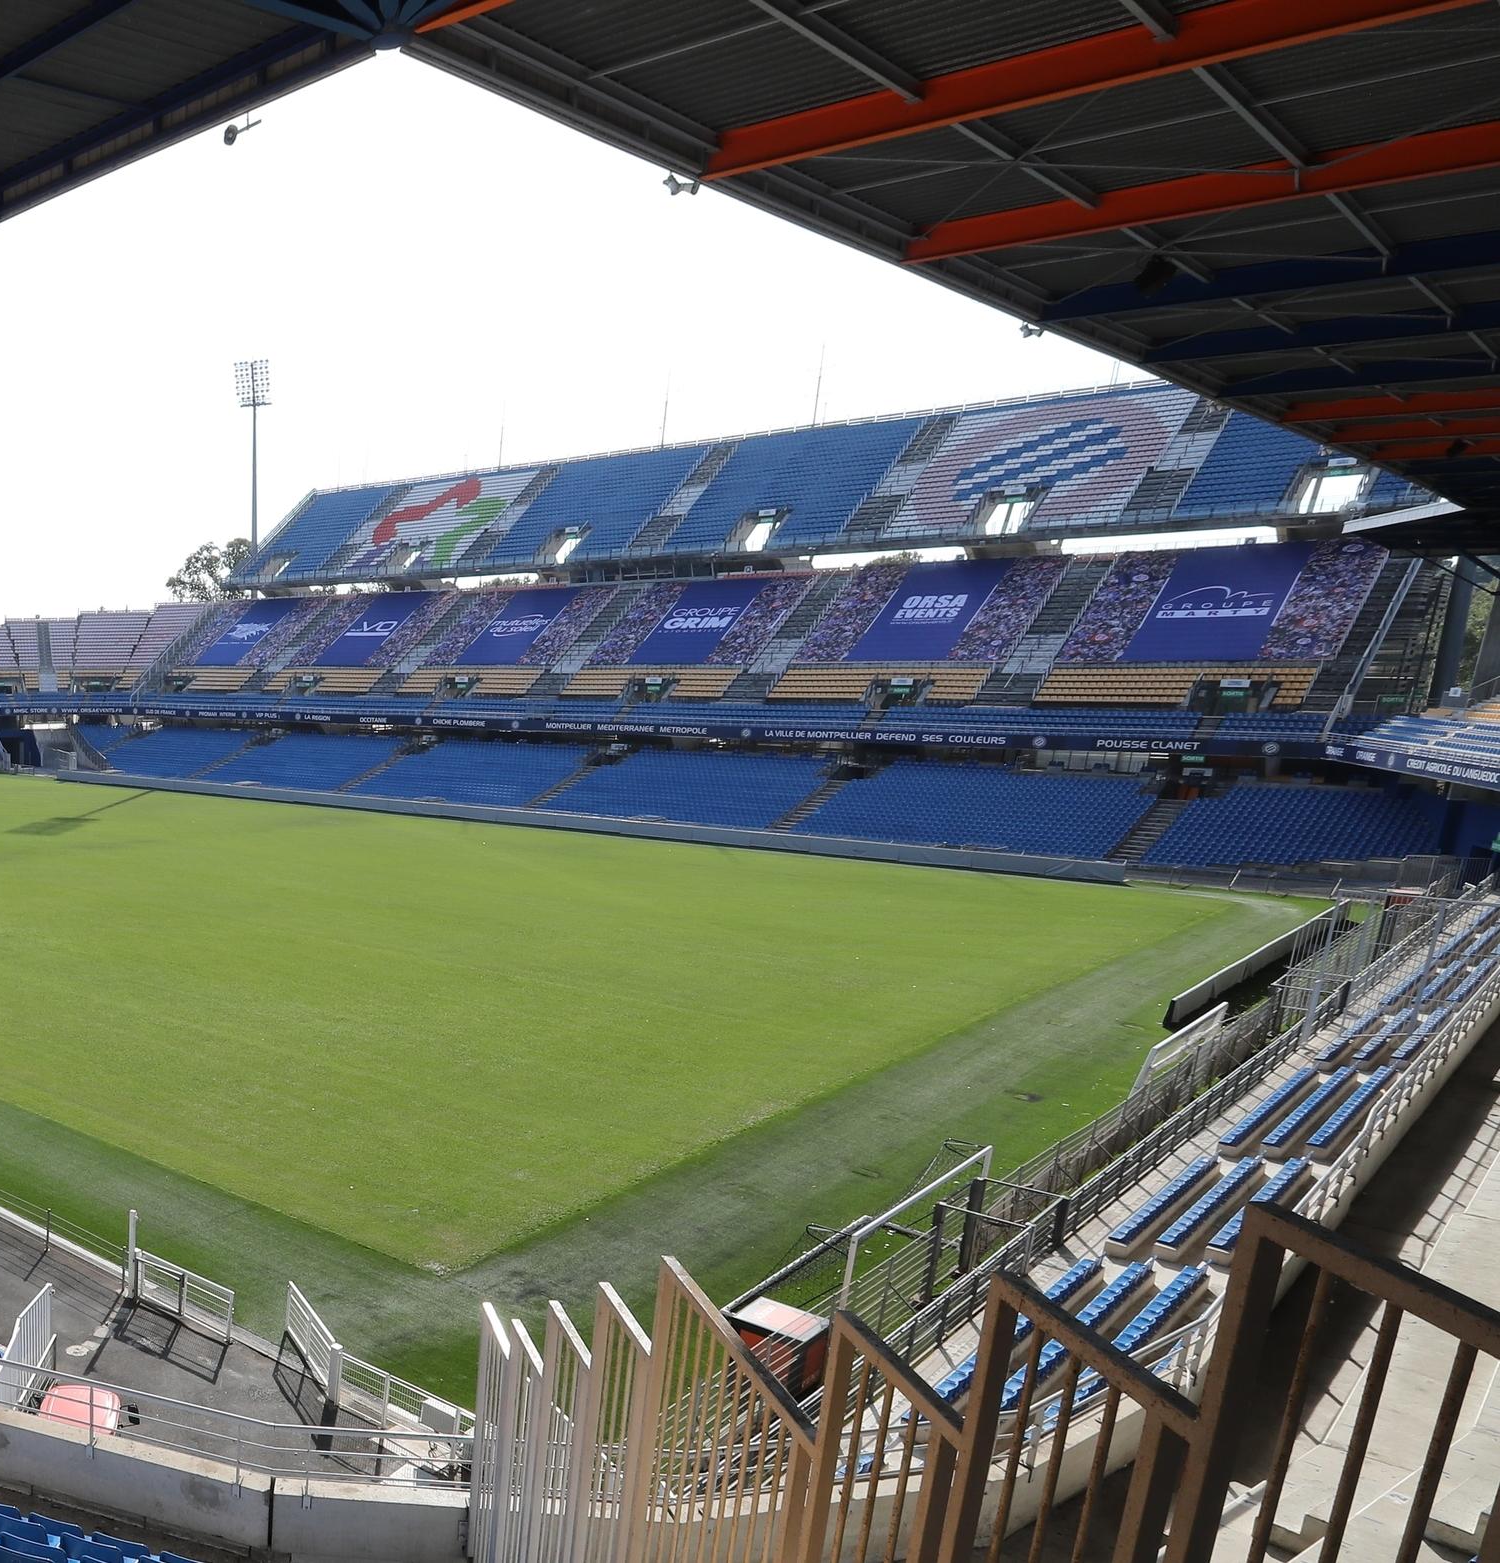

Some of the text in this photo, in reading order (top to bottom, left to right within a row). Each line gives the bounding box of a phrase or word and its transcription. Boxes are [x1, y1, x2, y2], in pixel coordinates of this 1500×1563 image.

[902, 594, 969, 608] ORSA
[1162, 599, 1274, 610] GROUPE
[672, 606, 741, 617] GROUPE
[893, 607, 961, 619] EVENTS
[1161, 608, 1265, 617] MARTY
[490, 618, 552, 626] mutuelles
[663, 616, 734, 630] GRIM
[507, 625, 541, 633] soleil
[311, 714, 331, 722] REGION
[359, 716, 387, 724] OCCITANIE
[452, 719, 486, 728] PLOMBERIE
[545, 722, 592, 731] MONTPELLIER
[659, 725, 708, 735] METROPOLE
[764, 729, 1007, 745] LA VILLE DE MONTPELLIER DEFEND SES COULEURS
[1096, 738, 1201, 751] POUSSE CLANET
[1355, 750, 1377, 763] ORANGE
[1406, 758, 1499, 784] CREDIT AGRICOLE DU LANGUEDOC
